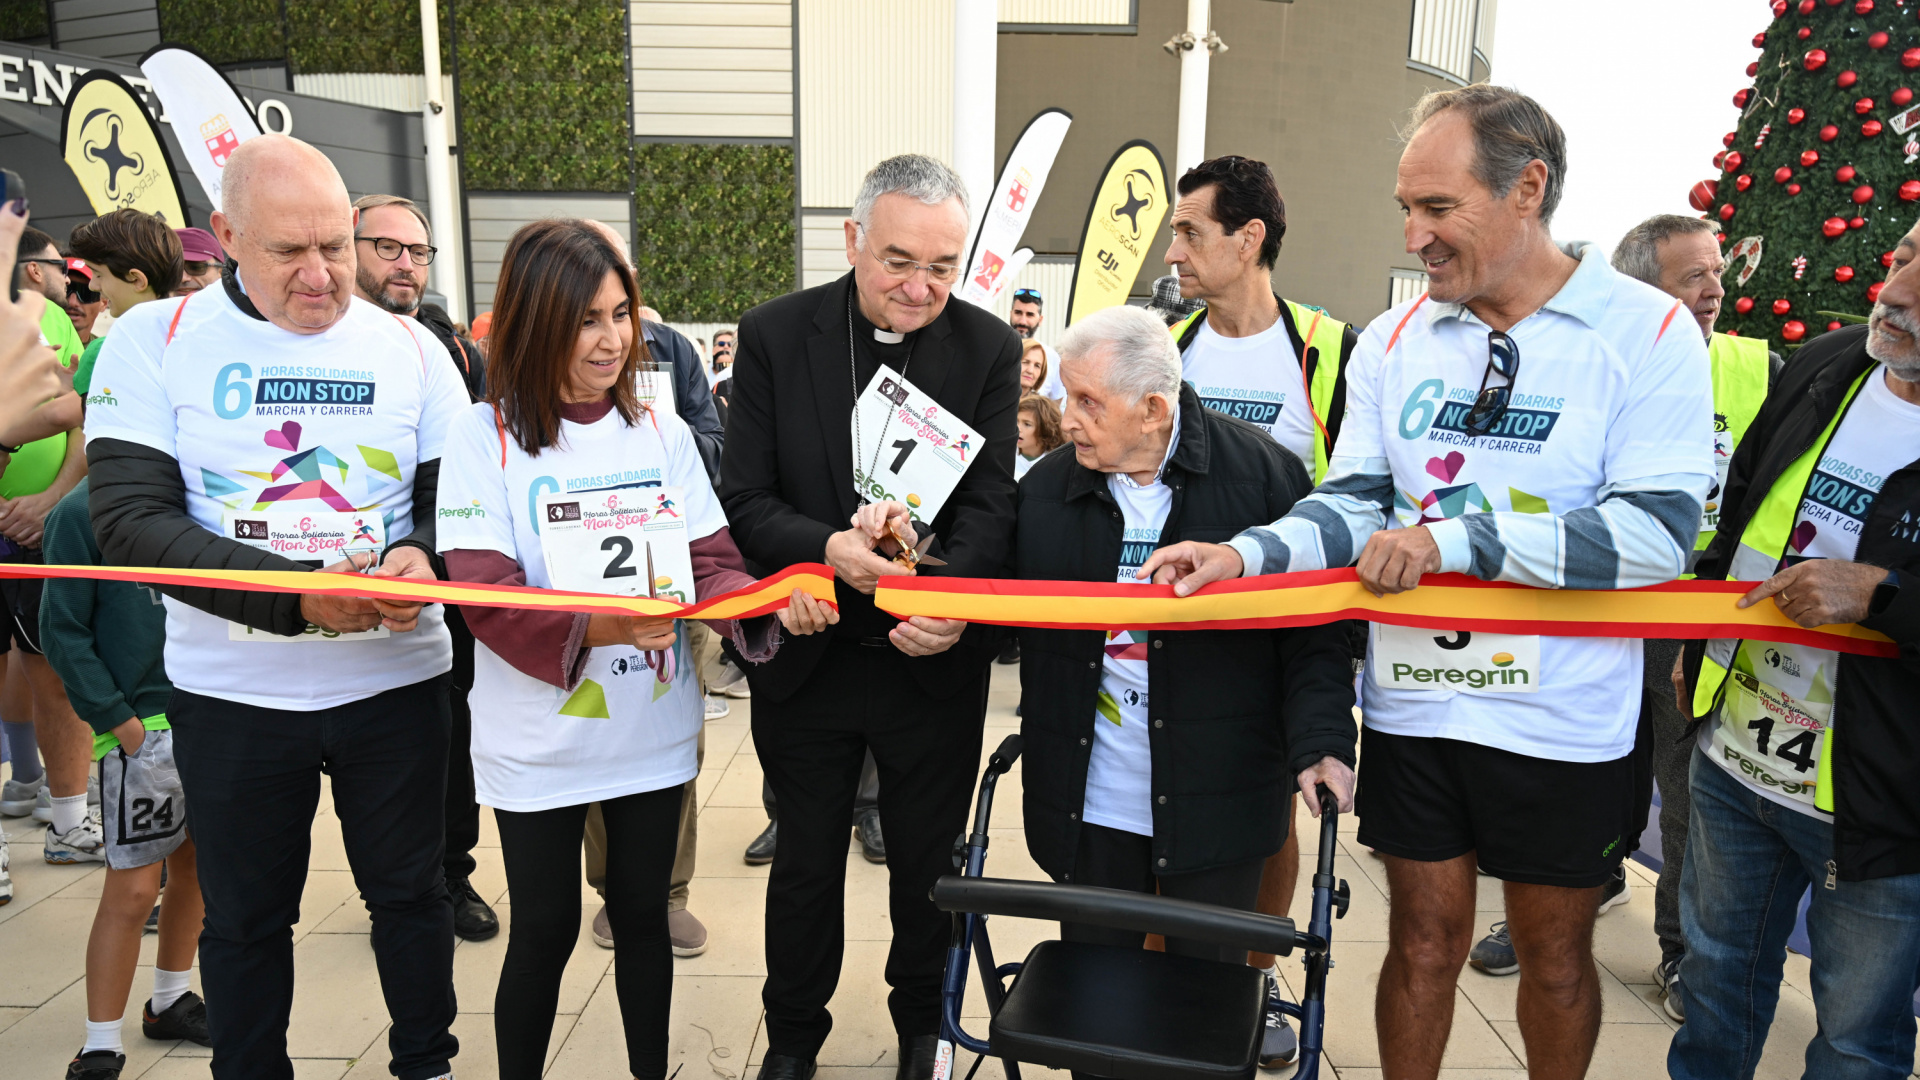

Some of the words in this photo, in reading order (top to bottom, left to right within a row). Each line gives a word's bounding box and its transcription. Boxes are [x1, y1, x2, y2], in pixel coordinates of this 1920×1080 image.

[1099, 216, 1139, 258] AEROSCAN
[261, 366, 304, 377] HORAS
[306, 367, 374, 380] SOLIDARIAS
[212, 362, 253, 420] 6
[263, 381, 311, 401] NON
[315, 383, 370, 402] STOP
[1201, 386, 1232, 397] HORAS
[1232, 388, 1286, 402] SOLIDARIAS
[256, 405, 305, 416] MARCHA
[310, 406, 317, 415] Y
[320, 406, 373, 416] CARRERA
[925, 406, 938, 419] 6
[1232, 402, 1277, 421] STOP
[1398, 378, 1444, 440] 6
[1441, 405, 1472, 429] NO
[898, 409, 920, 430] Non
[917, 424, 947, 448] Stop
[904, 403, 921, 419] Horas
[921, 416, 949, 440] Solidarias
[1428, 430, 1477, 448] MARCHA
[1480, 439, 1487, 449] Y
[1488, 439, 1542, 455] CARRERA
[889, 438, 918, 475] 1
[1820, 456, 1863, 481] HORAS
[566, 474, 603, 490] HORAS
[604, 467, 661, 485] SOLIDARIAS
[583, 511, 608, 519] Horas
[609, 507, 648, 517] Solidarias
[608, 494, 618, 508] 6
[1849, 494, 1873, 515] S
[299, 517, 311, 531] 6
[583, 518, 614, 530] Non
[615, 513, 651, 530] Stop
[1801, 501, 1832, 522] RCHA
[1833, 515, 1844, 526] Y
[271, 532, 299, 540] Horas
[300, 530, 345, 540] Solidarias
[271, 539, 305, 552] Non
[306, 537, 348, 553] Stop
[600, 535, 637, 579] 2
[1120, 544, 1154, 564] NON
[1392, 663, 1529, 688] Peregrin
[1758, 695, 1785, 716] Non
[1784, 709, 1823, 731] Stop
[1747, 716, 1817, 774] 14
[1723, 744, 1816, 797] Peregr
[132, 796, 173, 833] 24
